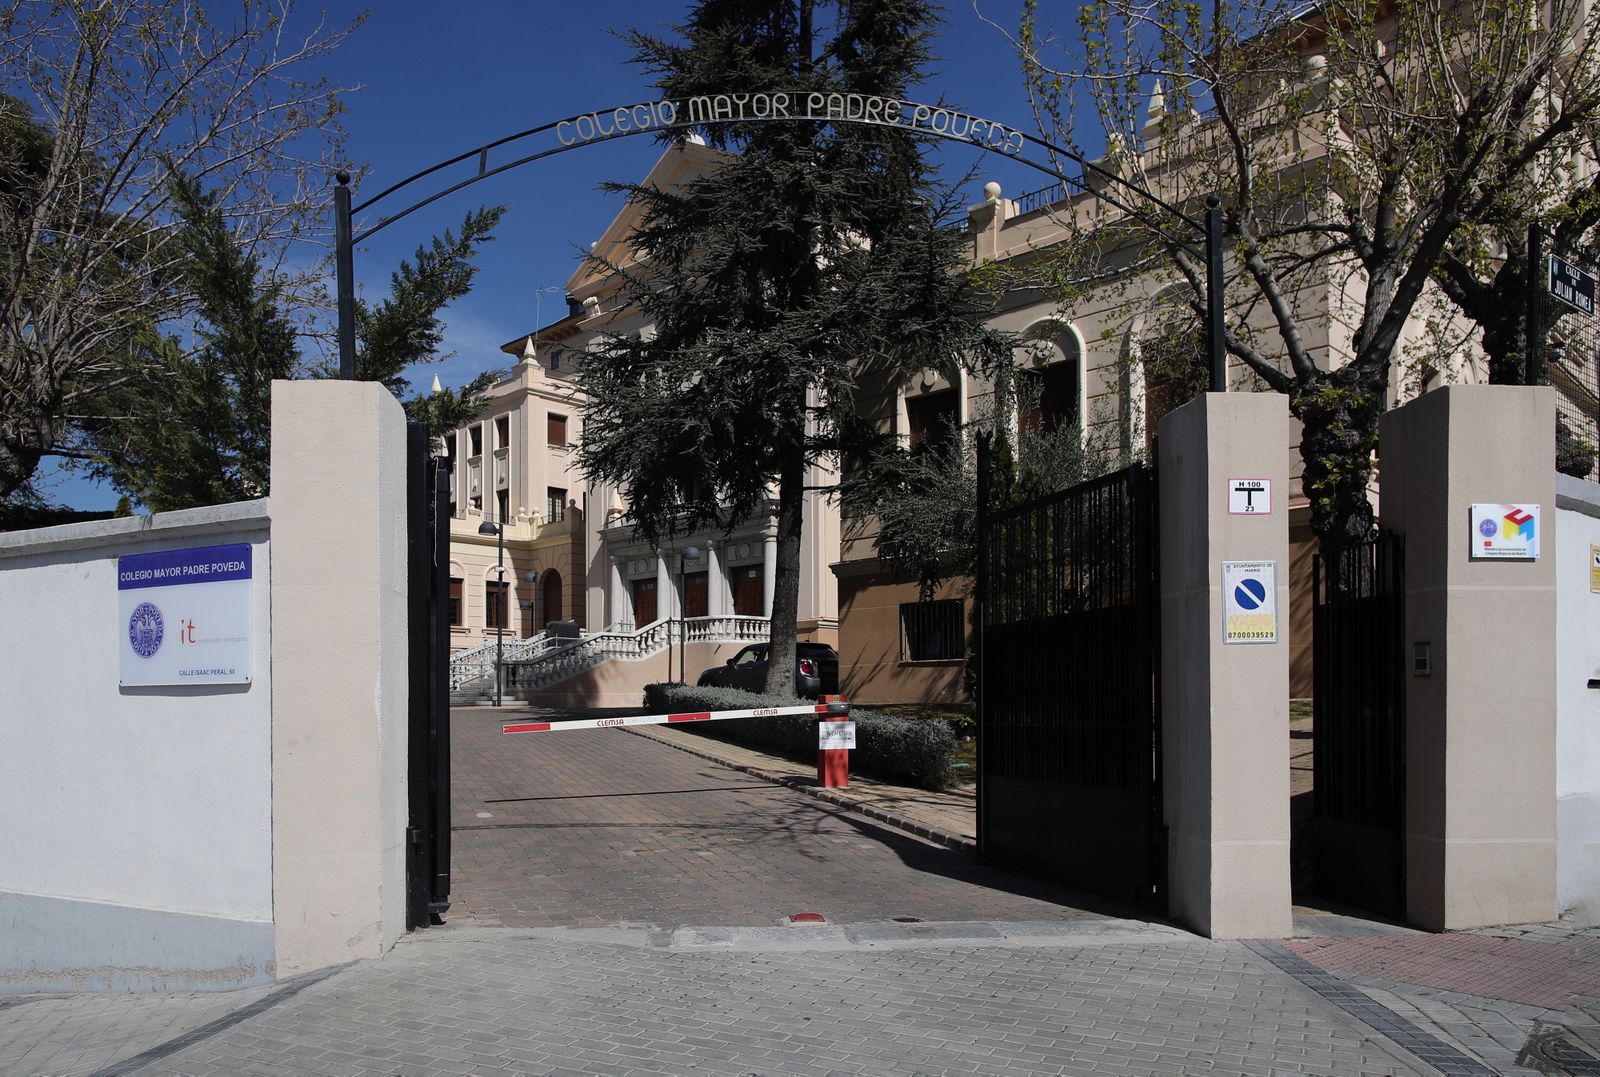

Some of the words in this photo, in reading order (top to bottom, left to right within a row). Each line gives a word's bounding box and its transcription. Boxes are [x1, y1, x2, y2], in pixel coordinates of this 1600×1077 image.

[555, 99, 677, 147] COLEGIO
[689, 93, 790, 124] MAYOR
[807, 92, 901, 124] PADRE
[1565, 264, 1581, 281] CALLE
[120, 569, 153, 582] COLEGIO
[153, 566, 181, 579] MAYOR
[182, 563, 210, 576] PADRE
[211, 560, 246, 573] POVEDA
[181, 619, 196, 644] it
[753, 708, 779, 716] CLEMSA
[596, 718, 624, 727] CLEMSA
